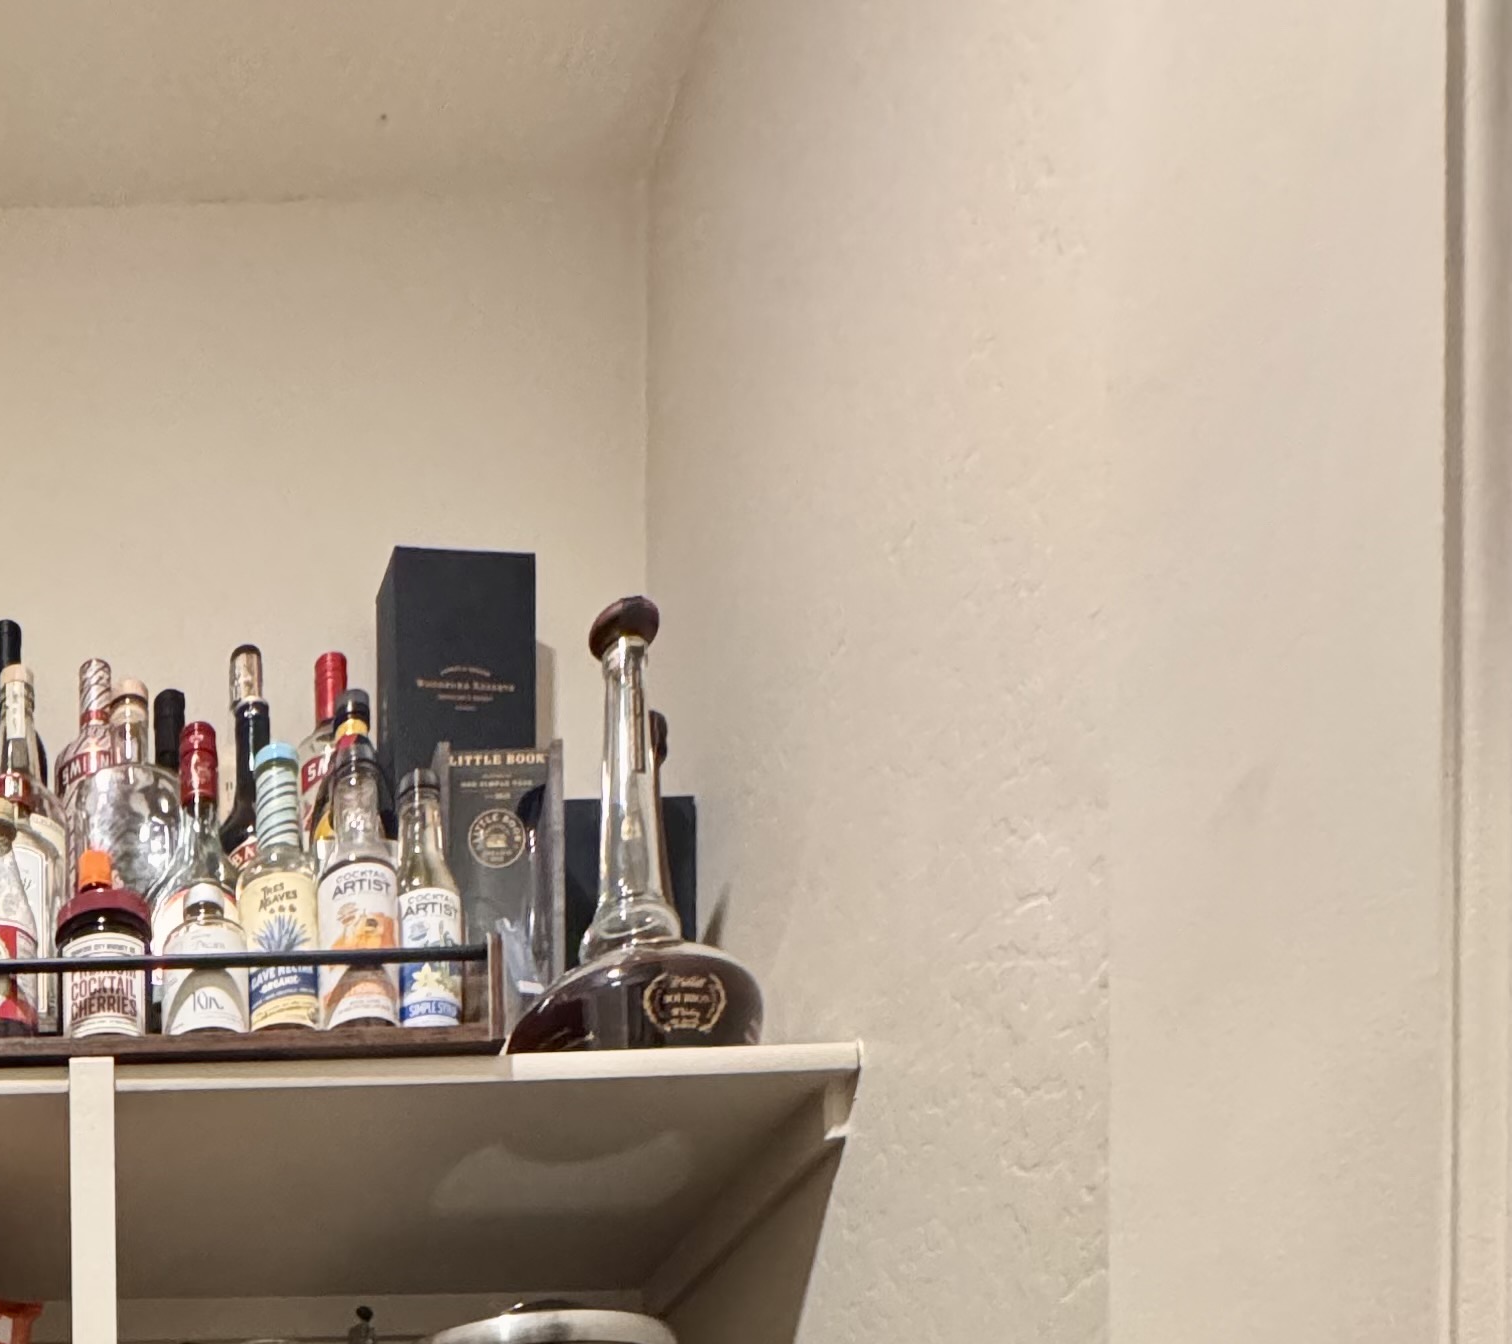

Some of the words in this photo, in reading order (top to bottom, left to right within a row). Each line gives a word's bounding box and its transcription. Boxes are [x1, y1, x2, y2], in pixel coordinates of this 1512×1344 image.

[448, 753, 502, 767] LITTLE
[506, 753, 546, 765] BOOK
[261, 882, 285, 898] TRES
[332, 879, 392, 899] ARTIST
[258, 889, 298, 912] AGAVES
[402, 902, 458, 919] ARTIST
[72, 976, 137, 1001] COCKTAIL
[71, 996, 138, 1022] CHERRIES
